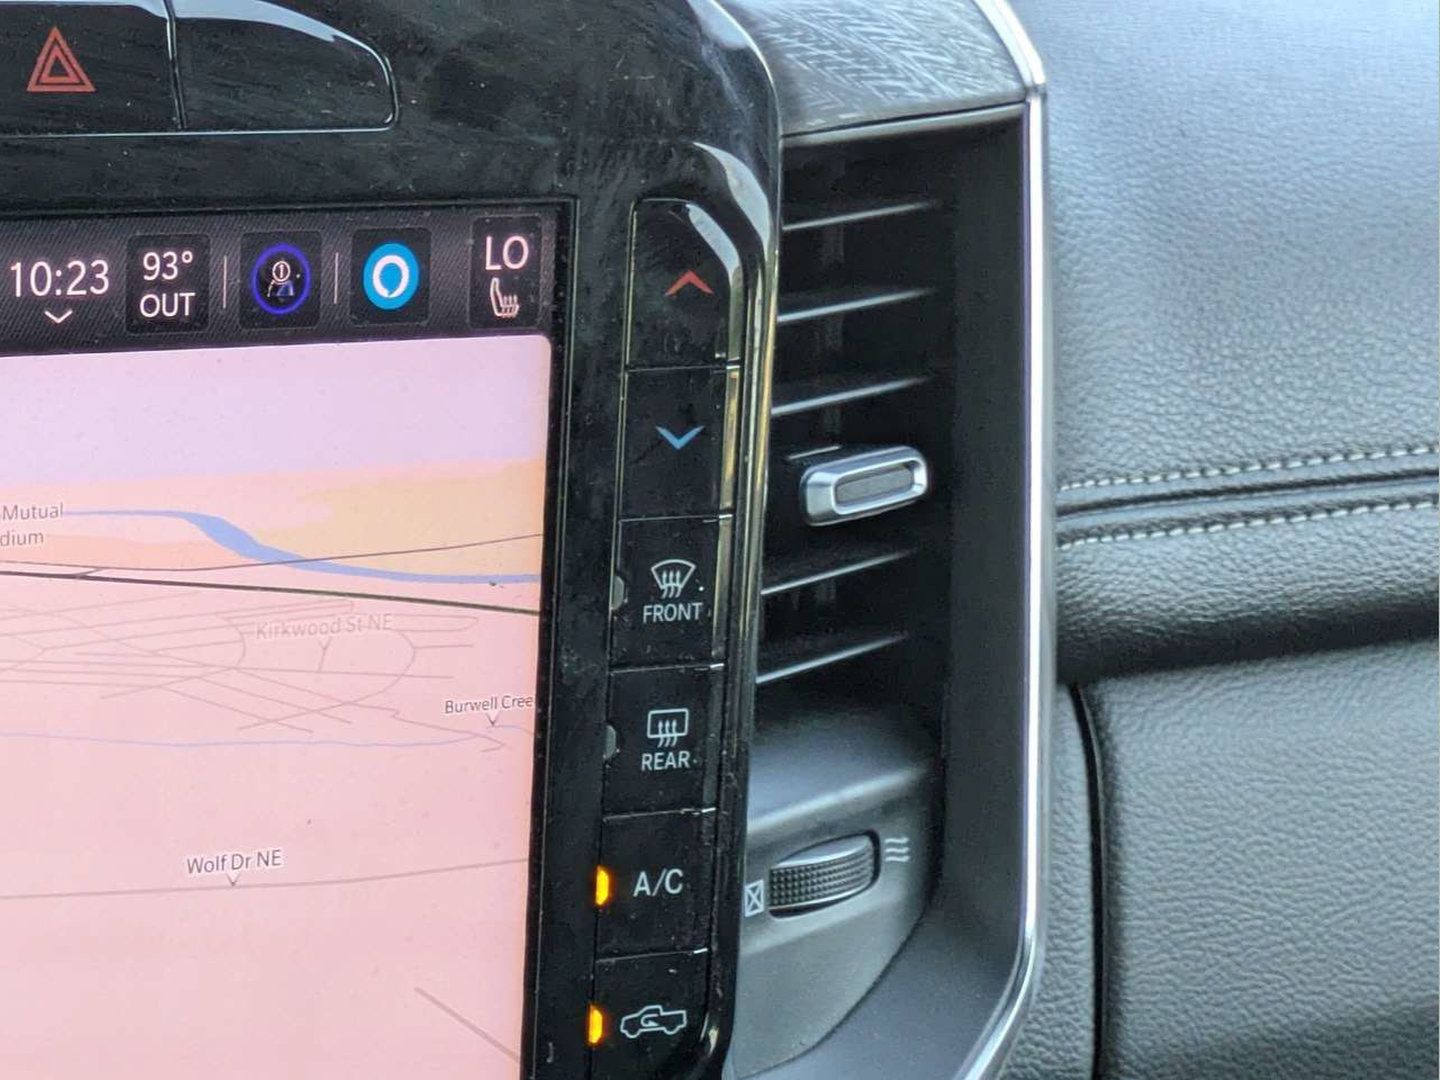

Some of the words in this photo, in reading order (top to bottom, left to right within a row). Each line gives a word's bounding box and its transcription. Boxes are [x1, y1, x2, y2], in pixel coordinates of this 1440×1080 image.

[142, 250, 194, 282] 93°
[485, 235, 529, 272] LO
[9, 258, 110, 298] 10:23
[139, 292, 196, 319] OUT
[1, 501, 64, 522] Mutual
[256, 616, 343, 640] Kirkwood
[347, 615, 362, 633] St
[368, 613, 393, 632] NE
[642, 602, 703, 624] FRONT
[444, 696, 498, 715] Burwell
[640, 750, 692, 773] REAR
[186, 854, 228, 875] Wolf
[231, 853, 255, 871] Dr
[256, 849, 283, 868] NE
[633, 868, 685, 898] A/C
